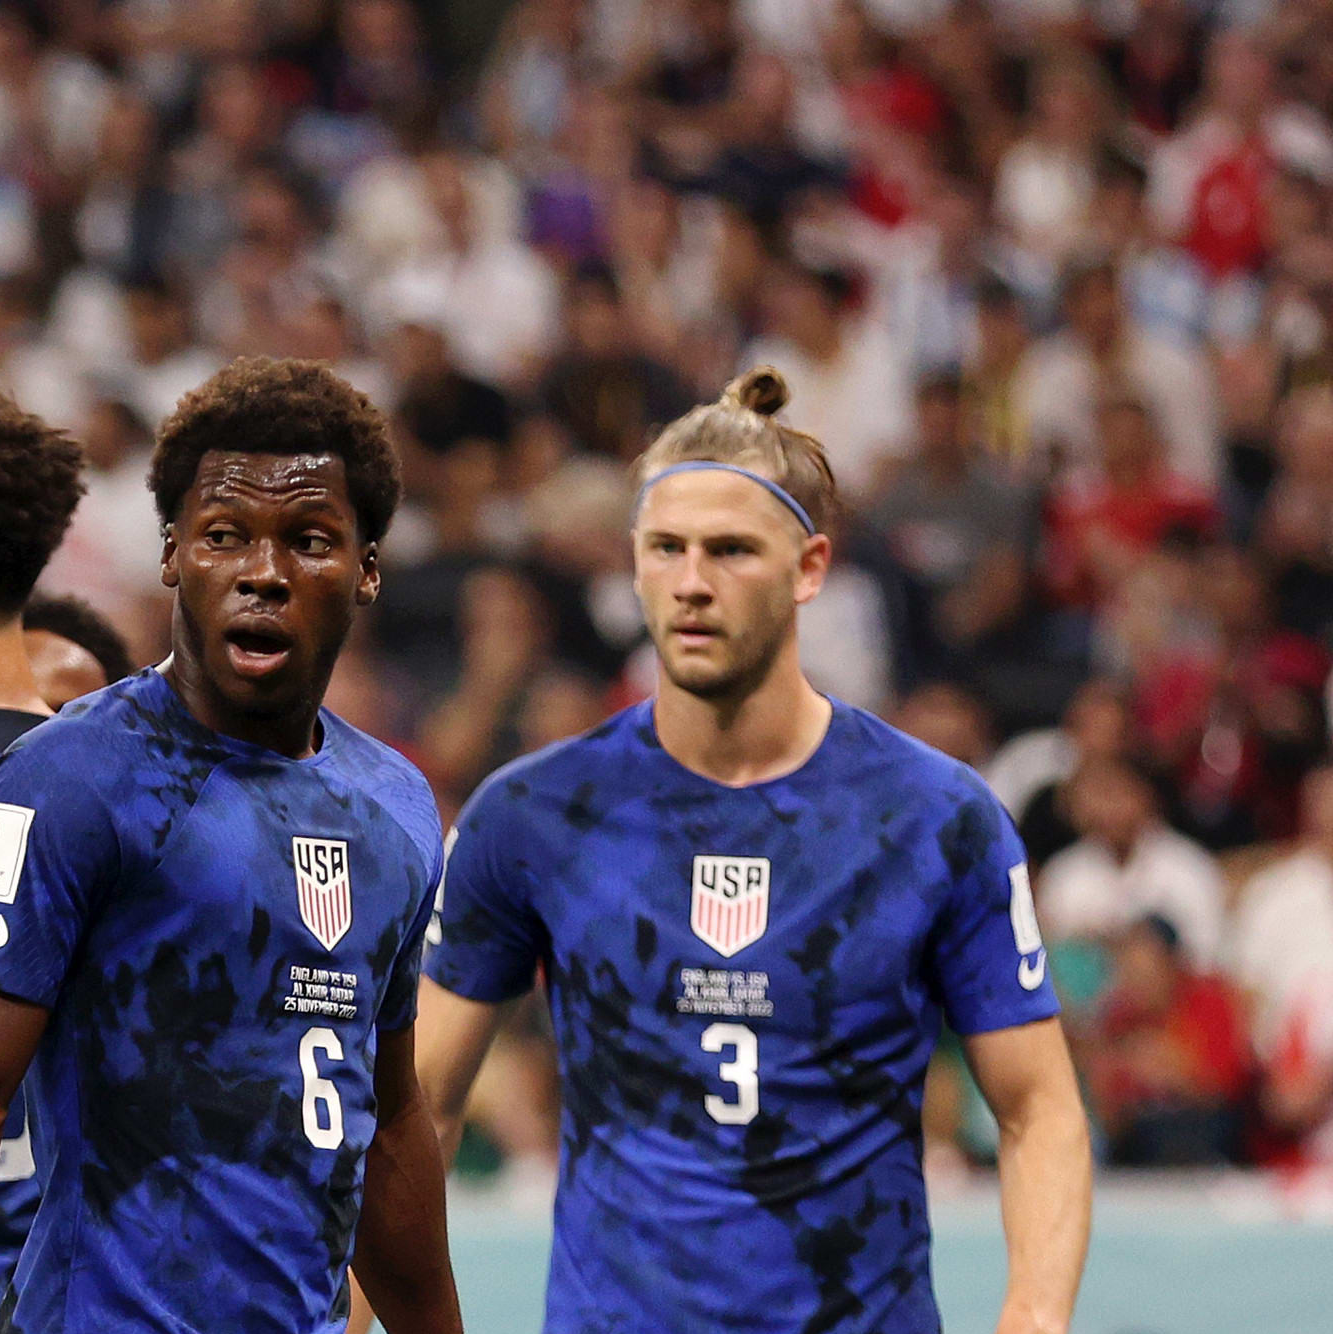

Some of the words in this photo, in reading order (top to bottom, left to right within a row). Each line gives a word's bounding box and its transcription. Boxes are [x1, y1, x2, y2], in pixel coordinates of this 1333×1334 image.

[297, 843, 344, 886] USA
[702, 864, 762, 898] USA
[290, 966, 329, 983] ENGLAND
[293, 982, 305, 997] AL
[285, 997, 297, 1012] 25
[297, 999, 338, 1016] NOVEMBER
[339, 1004, 357, 1019] 2022
[298, 1027, 345, 1151] 6
[700, 1022, 760, 1126] 3
